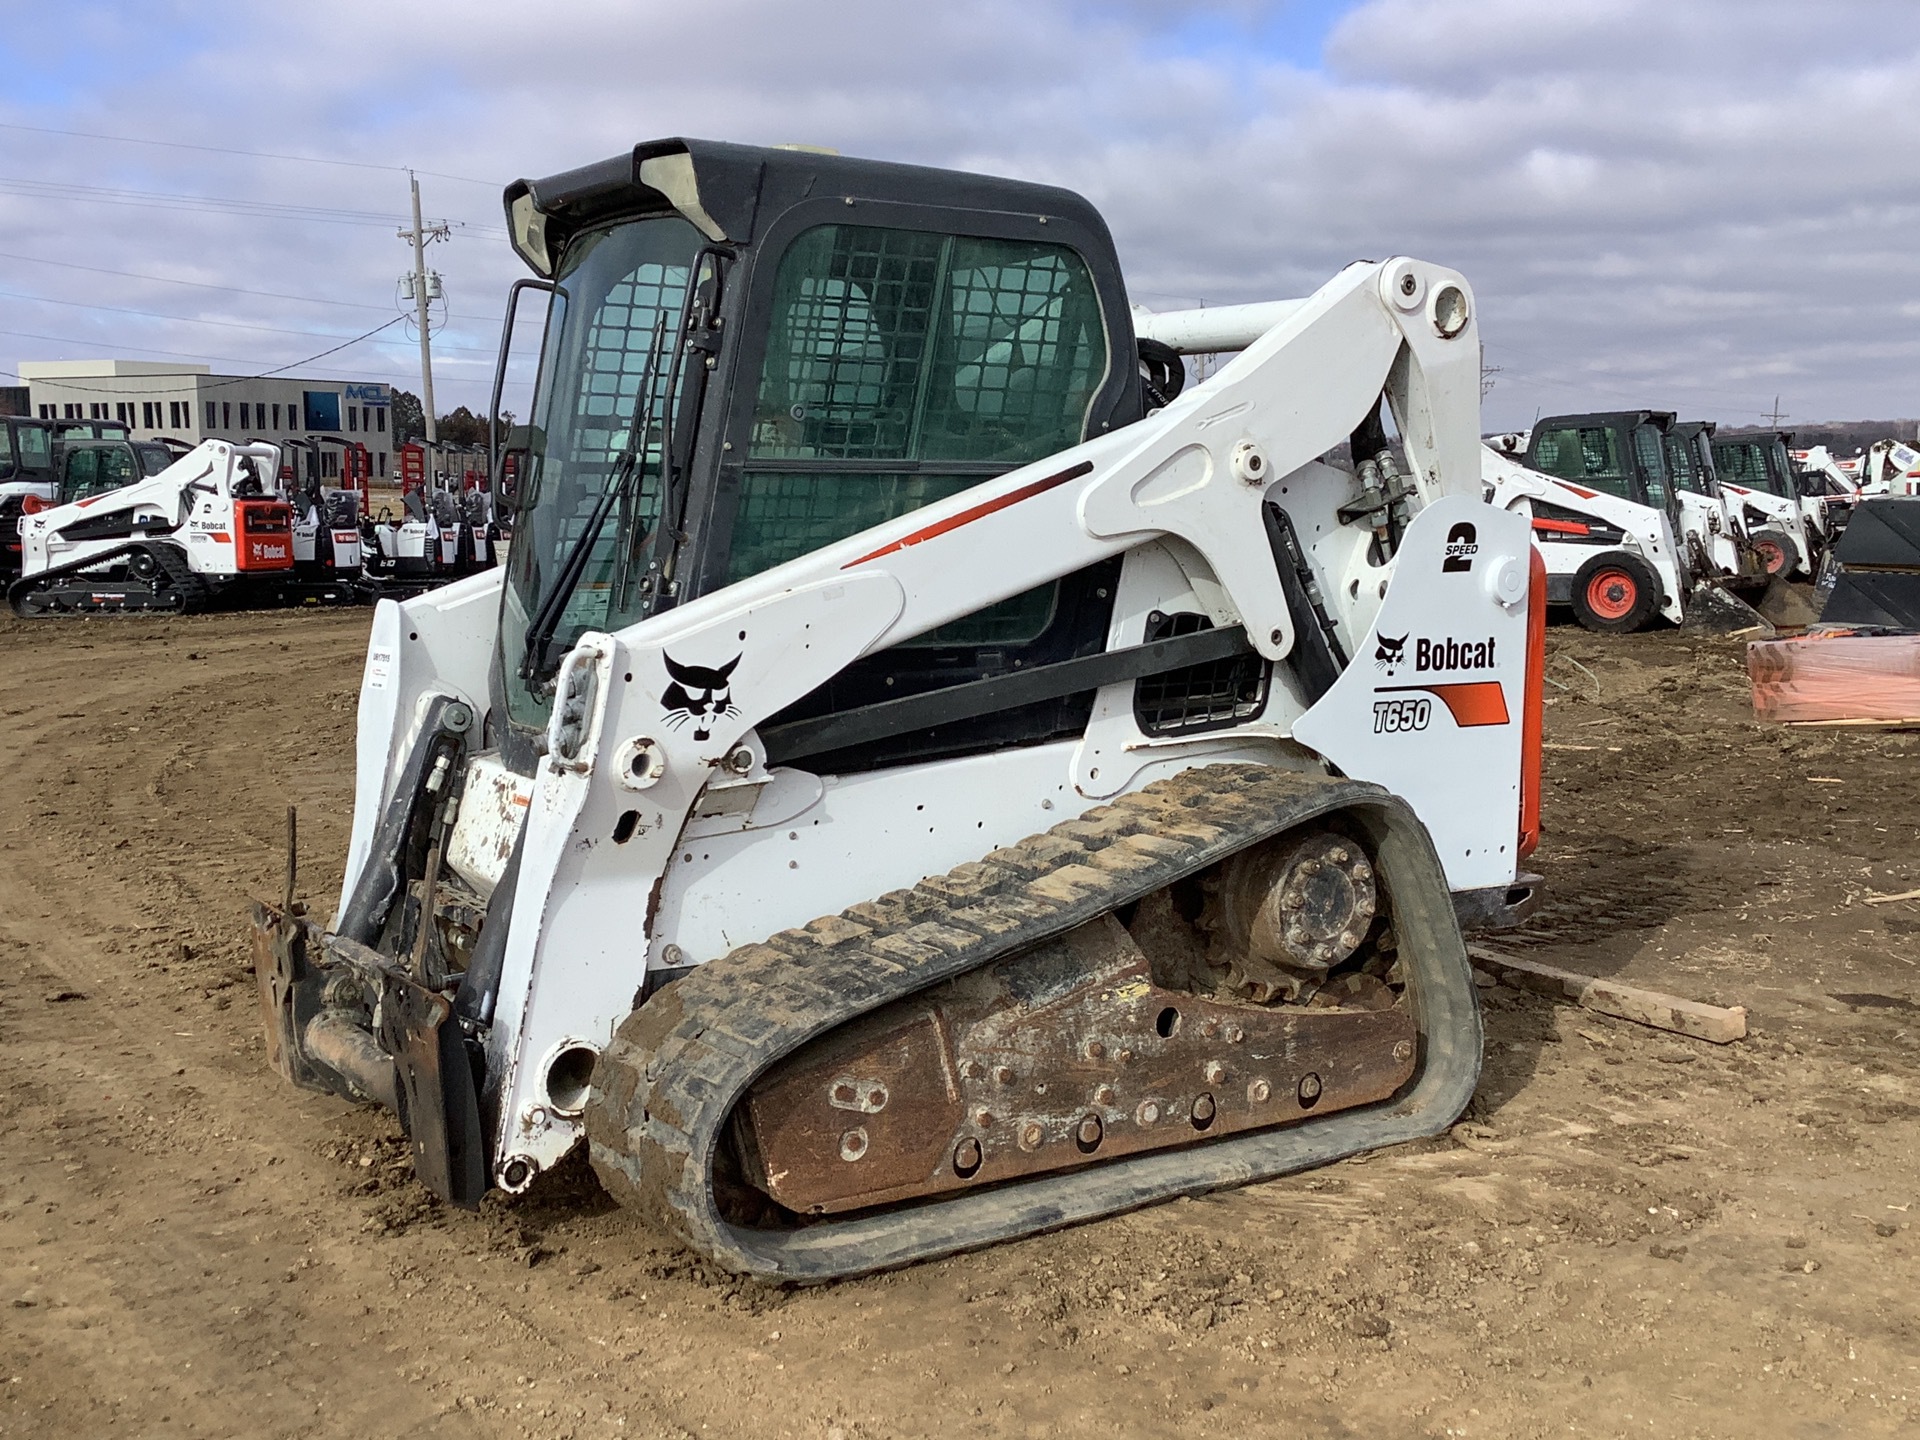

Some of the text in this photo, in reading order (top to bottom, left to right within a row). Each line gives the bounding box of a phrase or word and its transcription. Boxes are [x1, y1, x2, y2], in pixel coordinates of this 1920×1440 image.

[201, 521, 226, 530] Bobcat
[263, 545, 286, 559] Bobcat
[1442, 522, 1477, 573] 2
[1445, 545, 1478, 555] SPEED
[1416, 637, 1495, 671] Bobcat
[1373, 698, 1432, 734] T650
